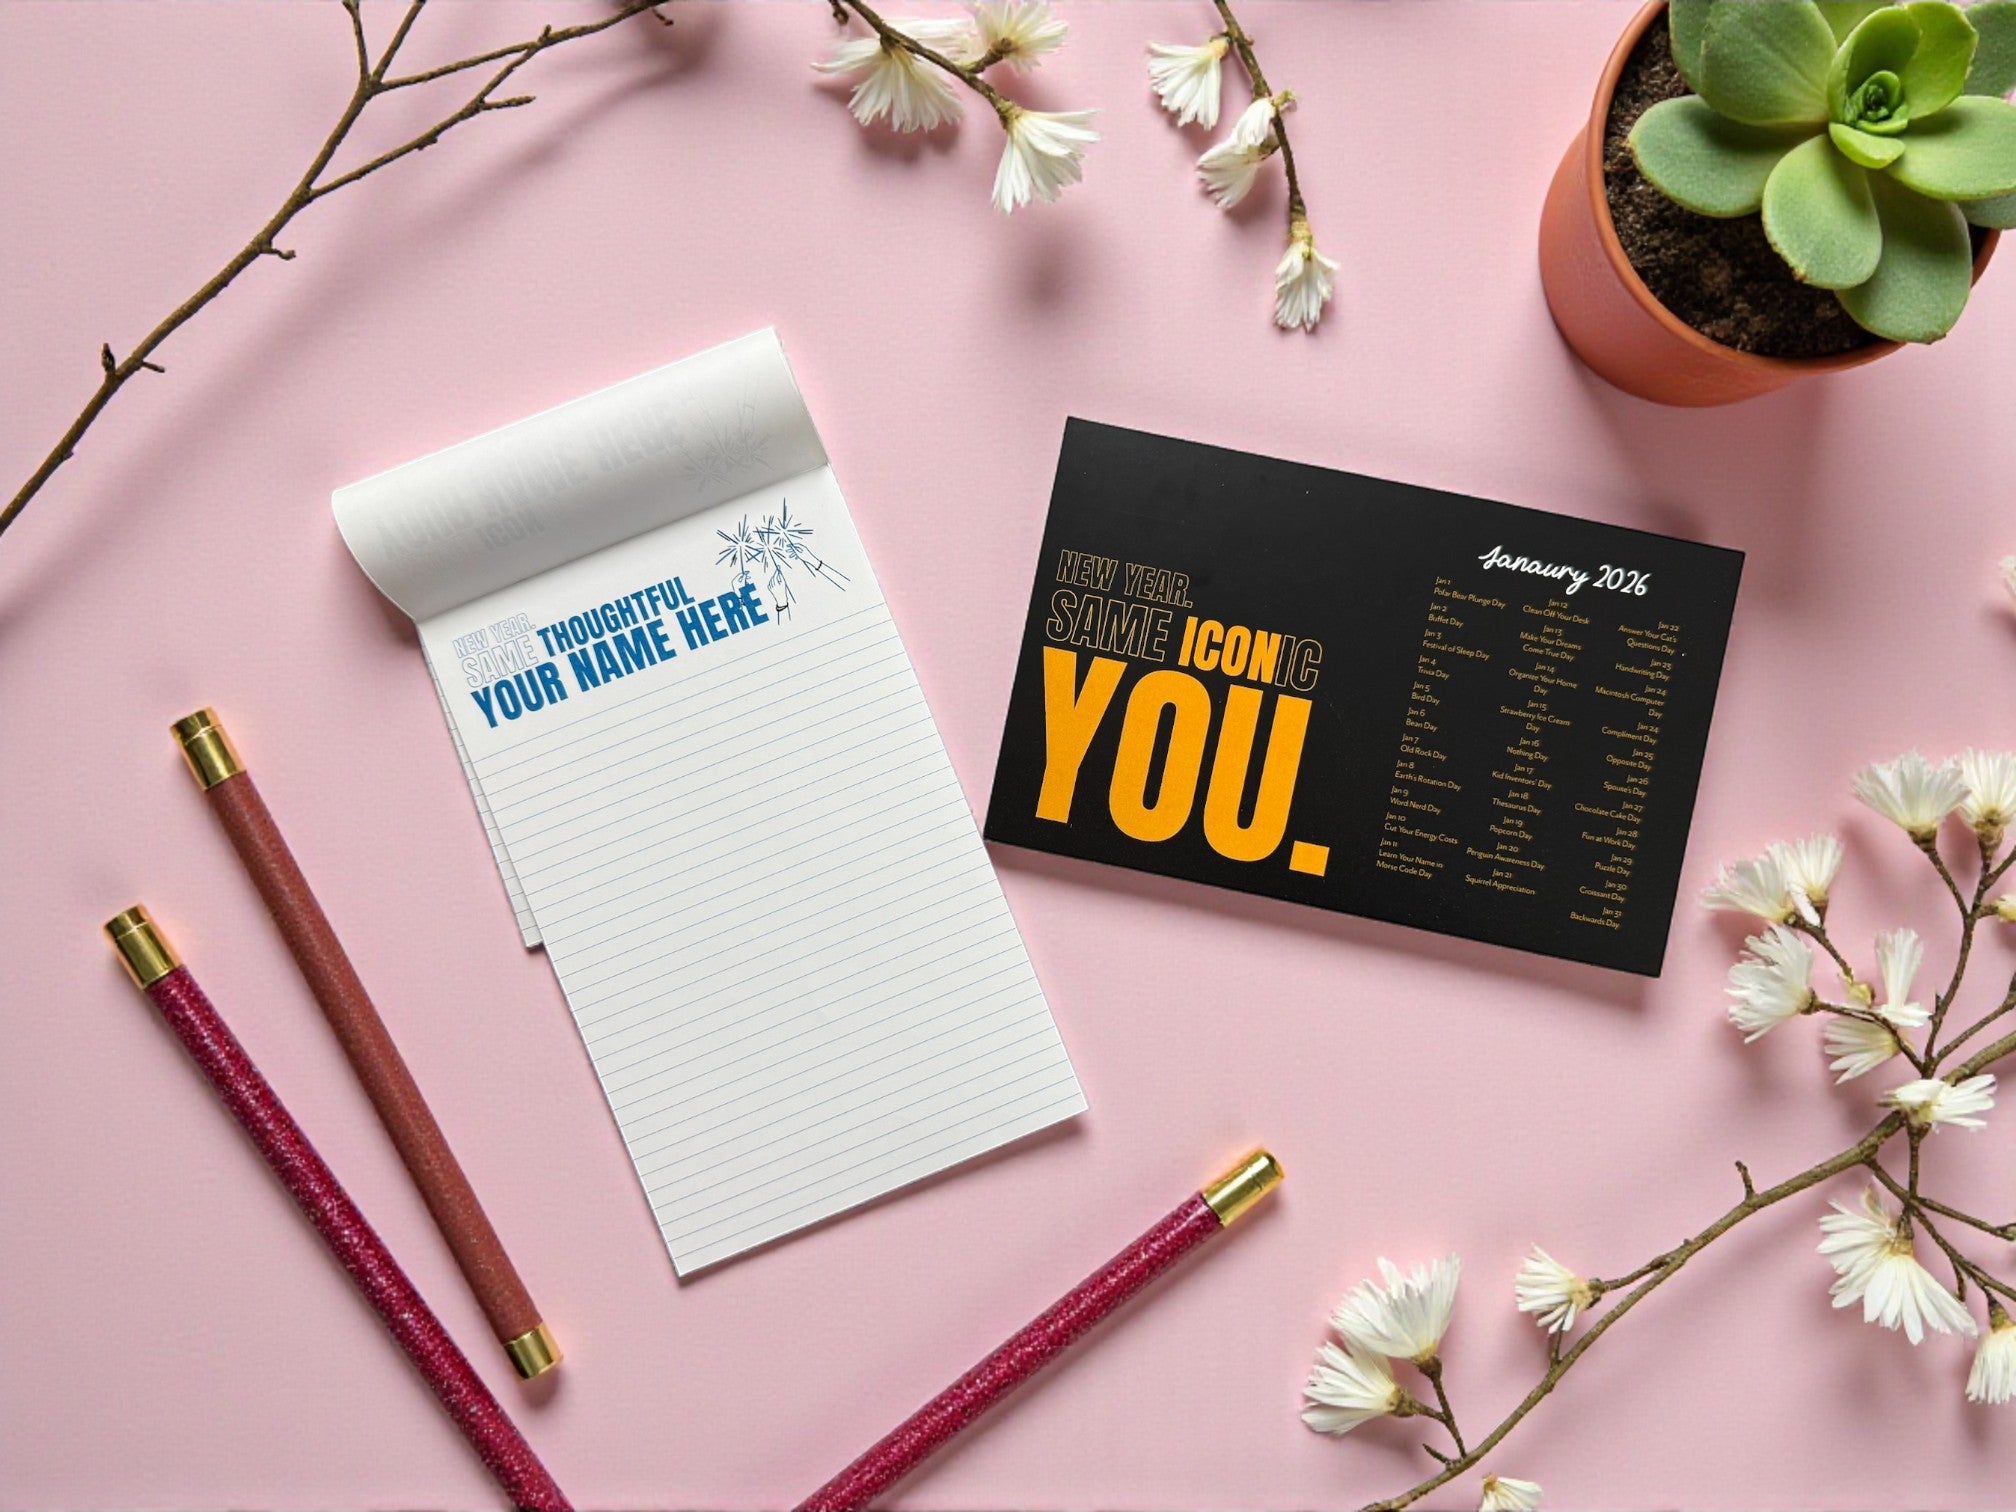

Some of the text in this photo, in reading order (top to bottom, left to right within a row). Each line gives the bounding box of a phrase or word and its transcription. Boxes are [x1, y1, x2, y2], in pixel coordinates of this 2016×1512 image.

[1477, 544, 1653, 597] Janaury 2026
[1056, 549, 1194, 608] NEW YEAR.
[1433, 586, 1506, 609] Polar Bear Plunge Day
[1547, 598, 1559, 607] Jan
[1429, 602, 1441, 611] Jan
[1522, 604, 1590, 624] Clean Off Your Desk
[1449, 617, 1463, 628] Day
[452, 612, 536, 659] NEW YEAR.
[462, 576, 695, 688] SAME THOUGHTFUL
[1423, 628, 1441, 639] Jan 3
[1617, 624, 1643, 635] Answer
[1644, 629, 1659, 639] Your
[1045, 589, 1324, 692] SAME ICONIC
[1519, 631, 1581, 650] Make Your Dreams
[1626, 637, 1675, 655] Questions Day
[471, 583, 769, 728] YOUR NAME HERE
[1422, 639, 1447, 651] Festival
[1455, 646, 1475, 658] Sleep
[1474, 649, 1490, 661] Day
[1522, 643, 1574, 662] Come True Day
[1418, 654, 1429, 663] Jan
[1435, 669, 1449, 680] Day
[1534, 662, 1555, 674] Jan 14
[1539, 674, 1555, 683] Your
[1555, 677, 1577, 688] Home
[1655, 670, 1670, 681] Day
[1412, 680, 1430, 692] Jan 5
[1533, 684, 1548, 695] Day
[1644, 684, 1666, 696] Jan 24
[1411, 691, 1440, 705] Bird Day
[1527, 699, 1547, 711] Jan 15
[1629, 692, 1664, 706] Computer
[1407, 707, 1425, 716] Jan 6
[1647, 708, 1662, 719] Day
[1405, 717, 1437, 732] Bean Day
[1536, 713, 1547, 721] Ice
[1547, 715, 1570, 726] Cream
[1525, 722, 1540, 733] Day
[1636, 721, 1659, 733] Jan 24
[1401, 733, 1413, 741] Jan
[1601, 726, 1657, 745] Compliment Day
[1399, 743, 1446, 761] Old Rock Day
[1506, 745, 1548, 762] Nothing Day
[1631, 748, 1654, 760] Jan 25
[1035, 645, 1330, 877] YOU.
[1396, 759, 1414, 769] Jan 8
[1513, 763, 1525, 772] Jan
[1637, 760, 1652, 771] Day
[1417, 774, 1446, 787] Rotation
[1447, 780, 1461, 791] Day
[1491, 770, 1504, 779] Kid
[1537, 779, 1552, 790] Day
[1390, 785, 1409, 796] Jan 9
[1632, 786, 1647, 797] Day
[1390, 796, 1441, 815] Word Nerd Day
[1492, 797, 1541, 815] Thesaurus Day
[1621, 800, 1643, 812] Jan 27
[1385, 811, 1397, 820] Jan
[1574, 802, 1641, 824] Chocolate Cake Day
[1502, 815, 1523, 827] Jan 19
[1383, 822, 1458, 844] Cut Your Energy Costs
[1489, 824, 1533, 841] Popcorn Day
[1496, 841, 1507, 850] Jan
[1581, 831, 1595, 840] Fun
[1601, 835, 1621, 846] Work
[1621, 839, 1636, 850] Day
[1378, 848, 1435, 867] Learn Your Name
[1466, 846, 1545, 871] Penguin Awareness Day
[1375, 859, 1432, 878] Morse Code Day
[1492, 868, 1504, 877] Jan
[1616, 865, 1630, 877] Day
[1464, 874, 1535, 895] Squirrel Appreciation
[1610, 892, 1625, 902] Day
[1569, 911, 1620, 929] Backwards Day
